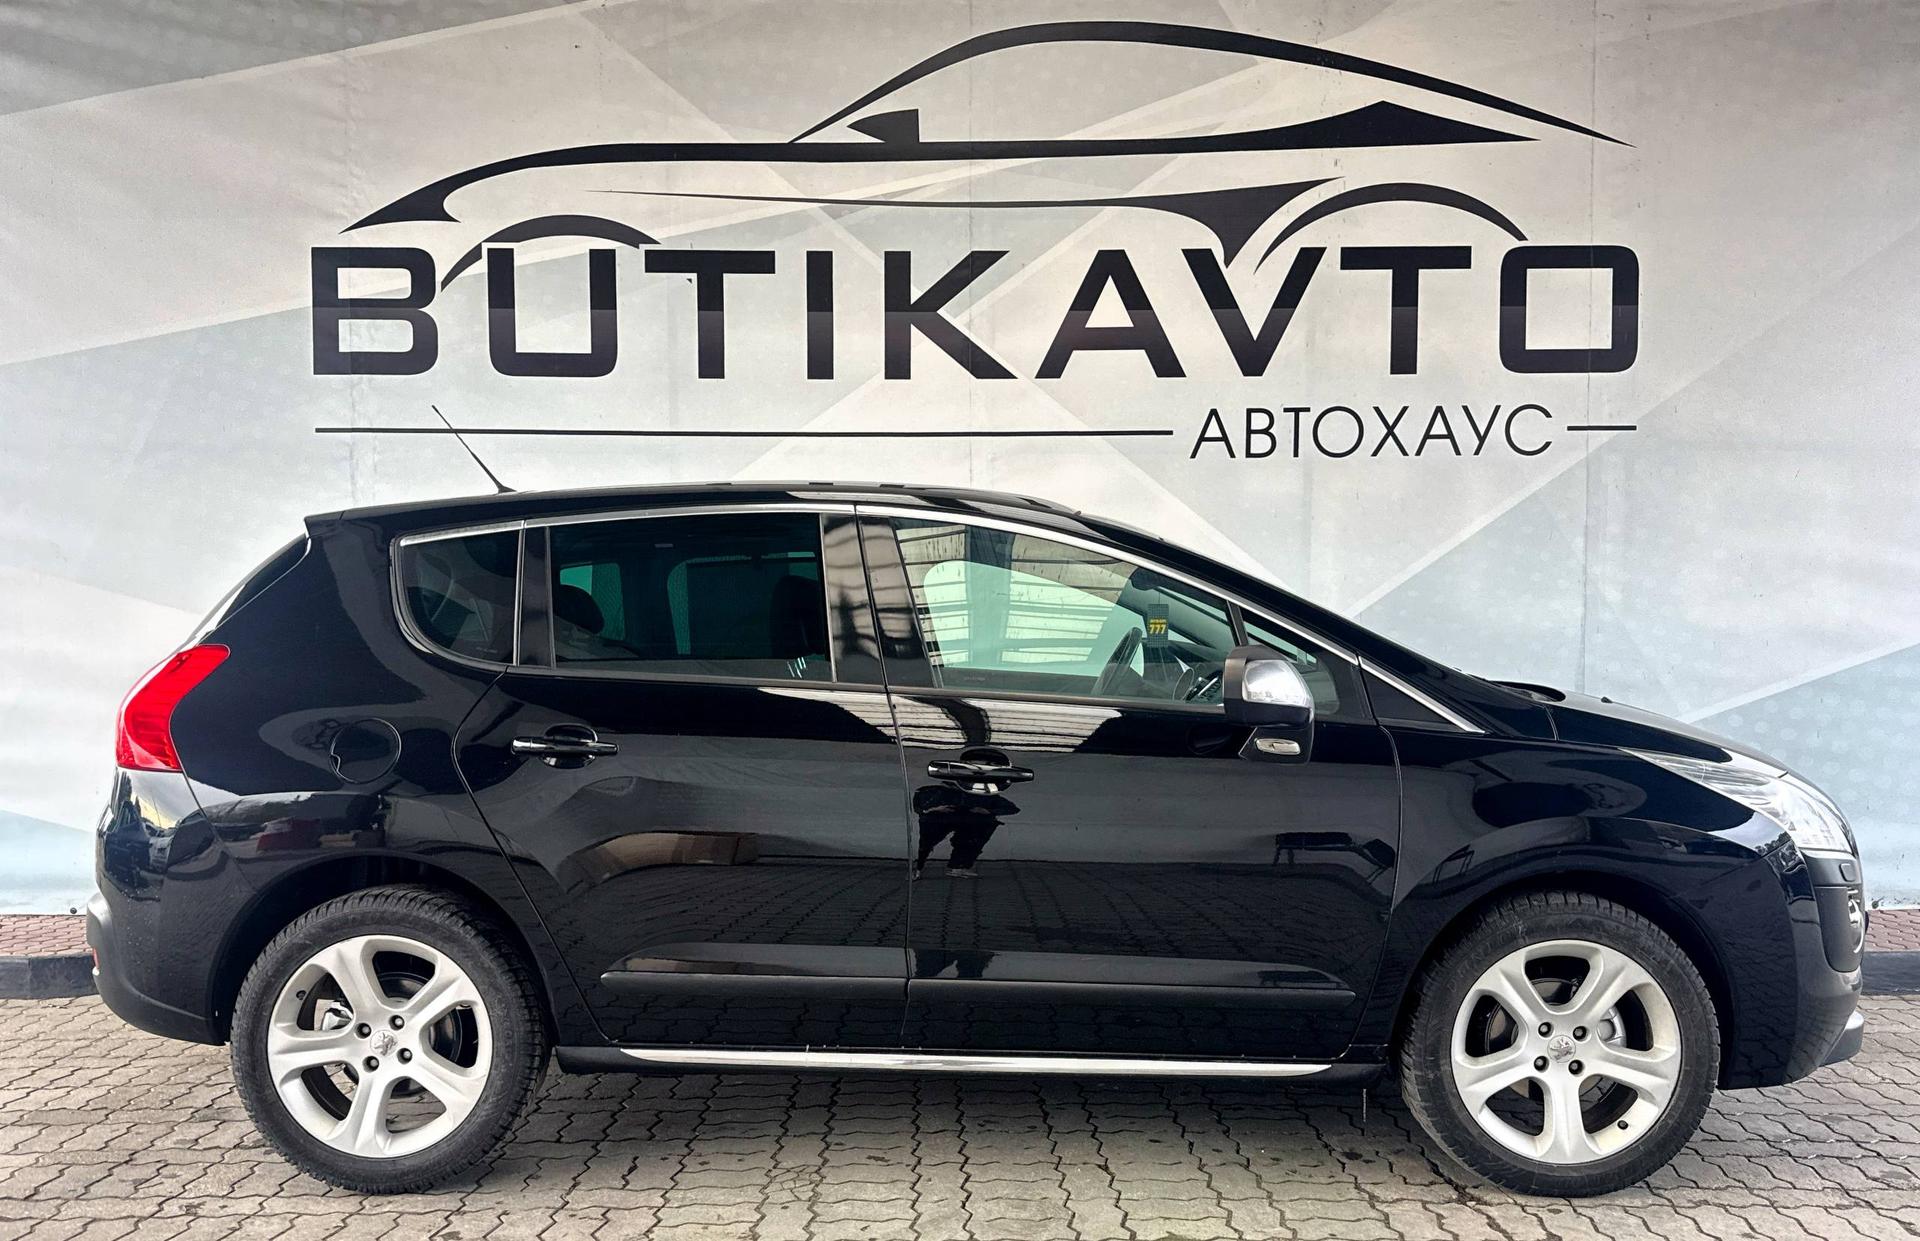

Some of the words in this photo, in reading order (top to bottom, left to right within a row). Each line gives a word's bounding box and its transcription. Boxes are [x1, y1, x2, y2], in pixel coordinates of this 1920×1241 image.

[311, 245, 1639, 380] BUTIKAVTO
[1190, 404, 1554, 459] АВТОХАУС
[1149, 624, 1167, 634] 777
